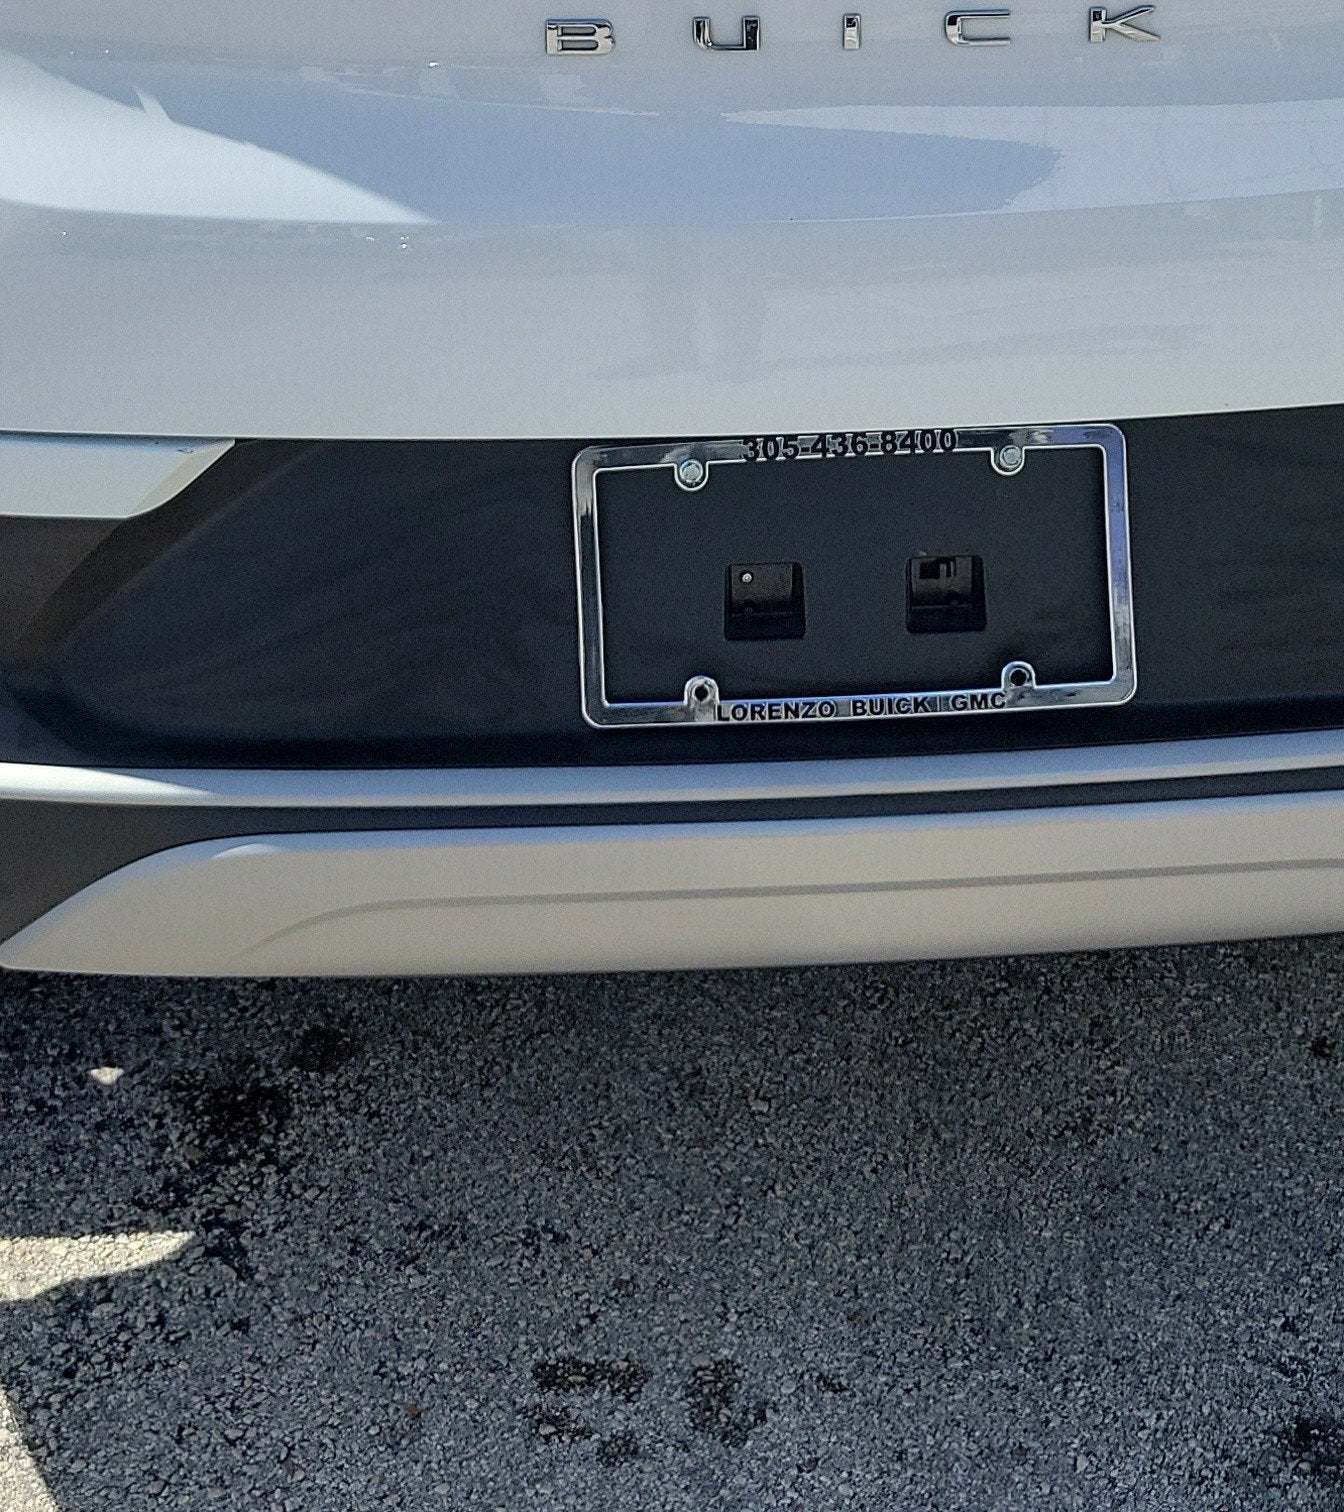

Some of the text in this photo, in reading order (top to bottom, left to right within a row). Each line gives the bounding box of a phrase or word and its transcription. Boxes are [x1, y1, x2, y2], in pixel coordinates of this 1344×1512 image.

[544, 4, 1161, 55] BUICK
[742, 429, 958, 462] 305-436-8400
[716, 692, 1007, 722] LORENZO BUICK GMC
